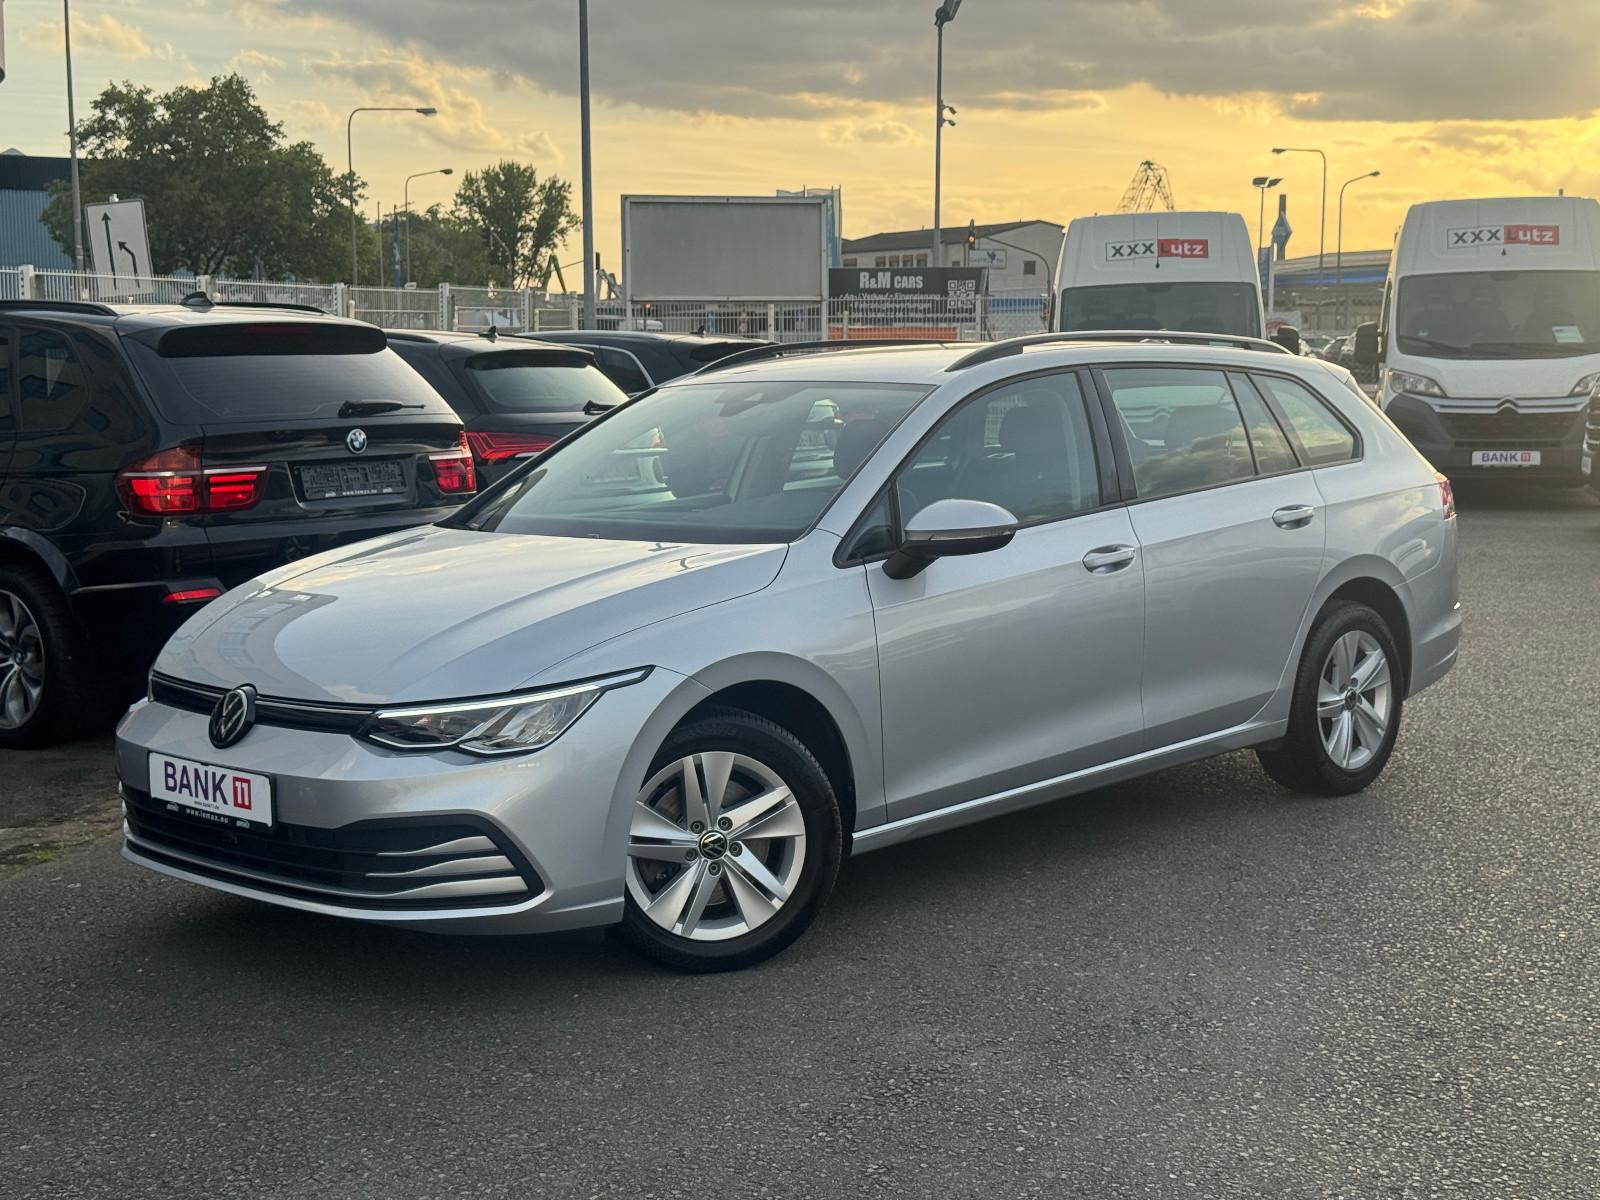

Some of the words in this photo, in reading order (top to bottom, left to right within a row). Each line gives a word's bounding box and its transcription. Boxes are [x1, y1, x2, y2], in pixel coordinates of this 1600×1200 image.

[859, 271, 891, 289] R&M
[894, 275, 923, 289] CARS
[1481, 452, 1519, 462] BANK
[164, 760, 228, 805] BANK
